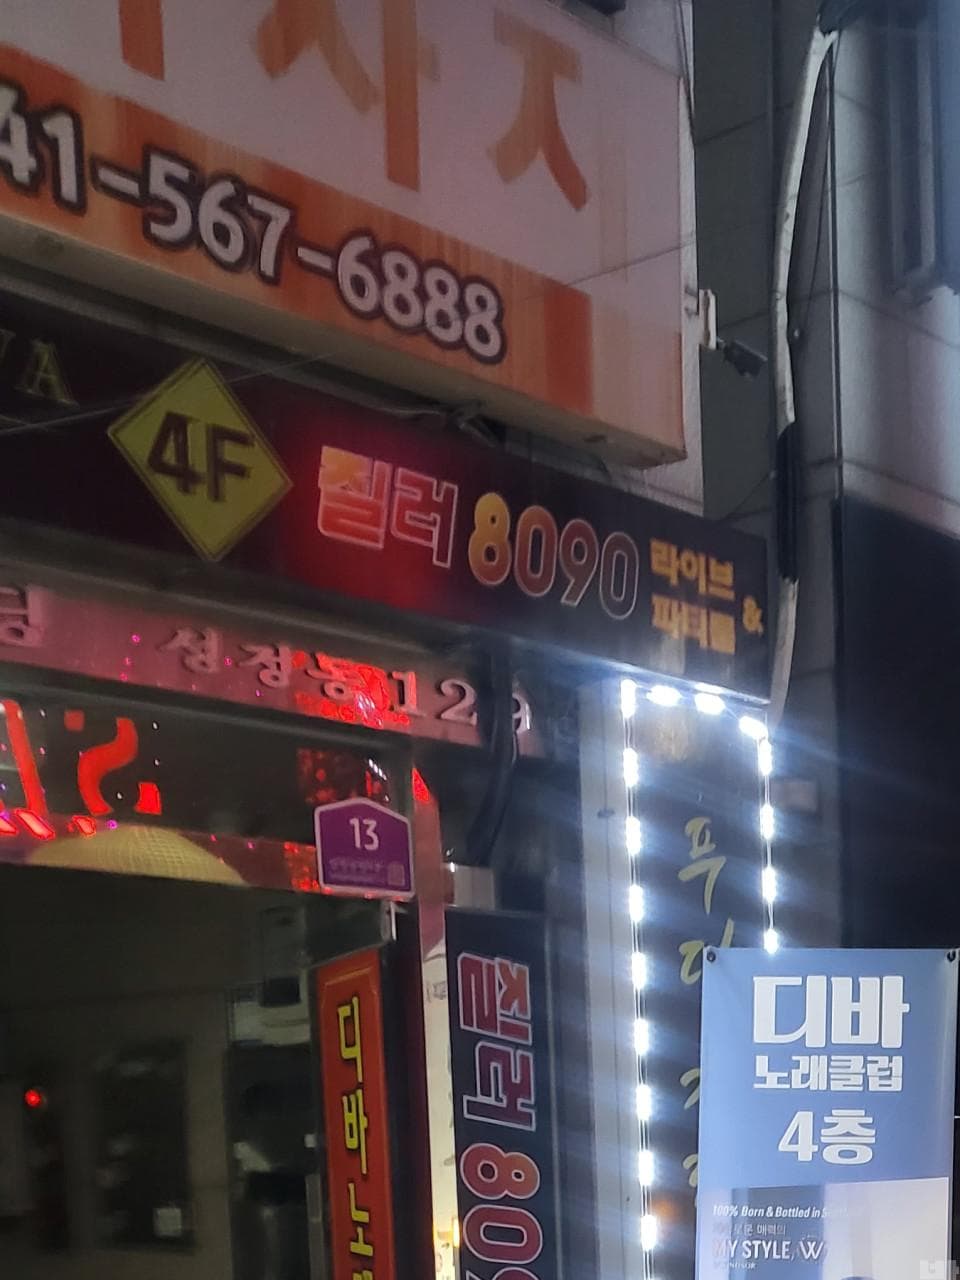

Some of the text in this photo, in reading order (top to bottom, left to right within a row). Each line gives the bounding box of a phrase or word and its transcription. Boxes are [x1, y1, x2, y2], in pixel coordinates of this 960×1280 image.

[148, 411, 255, 502] 4F
[317, 445, 640, 620] 질러 8090
[649, 537, 735, 600] 라이브
[349, 817, 380, 851] 13
[753, 975, 910, 1048] 디바
[458, 952, 537, 1132] 질러
[753, 1055, 903, 1092] 노래클럽
[778, 1109, 876, 1165] 4층
[712, 1204, 738, 1217] 100%
[741, 1205, 764, 1217] Born
[765, 1206, 773, 1218] &
[775, 1205, 810, 1218] Bottled
[742, 1240, 795, 1261] STYLE,
